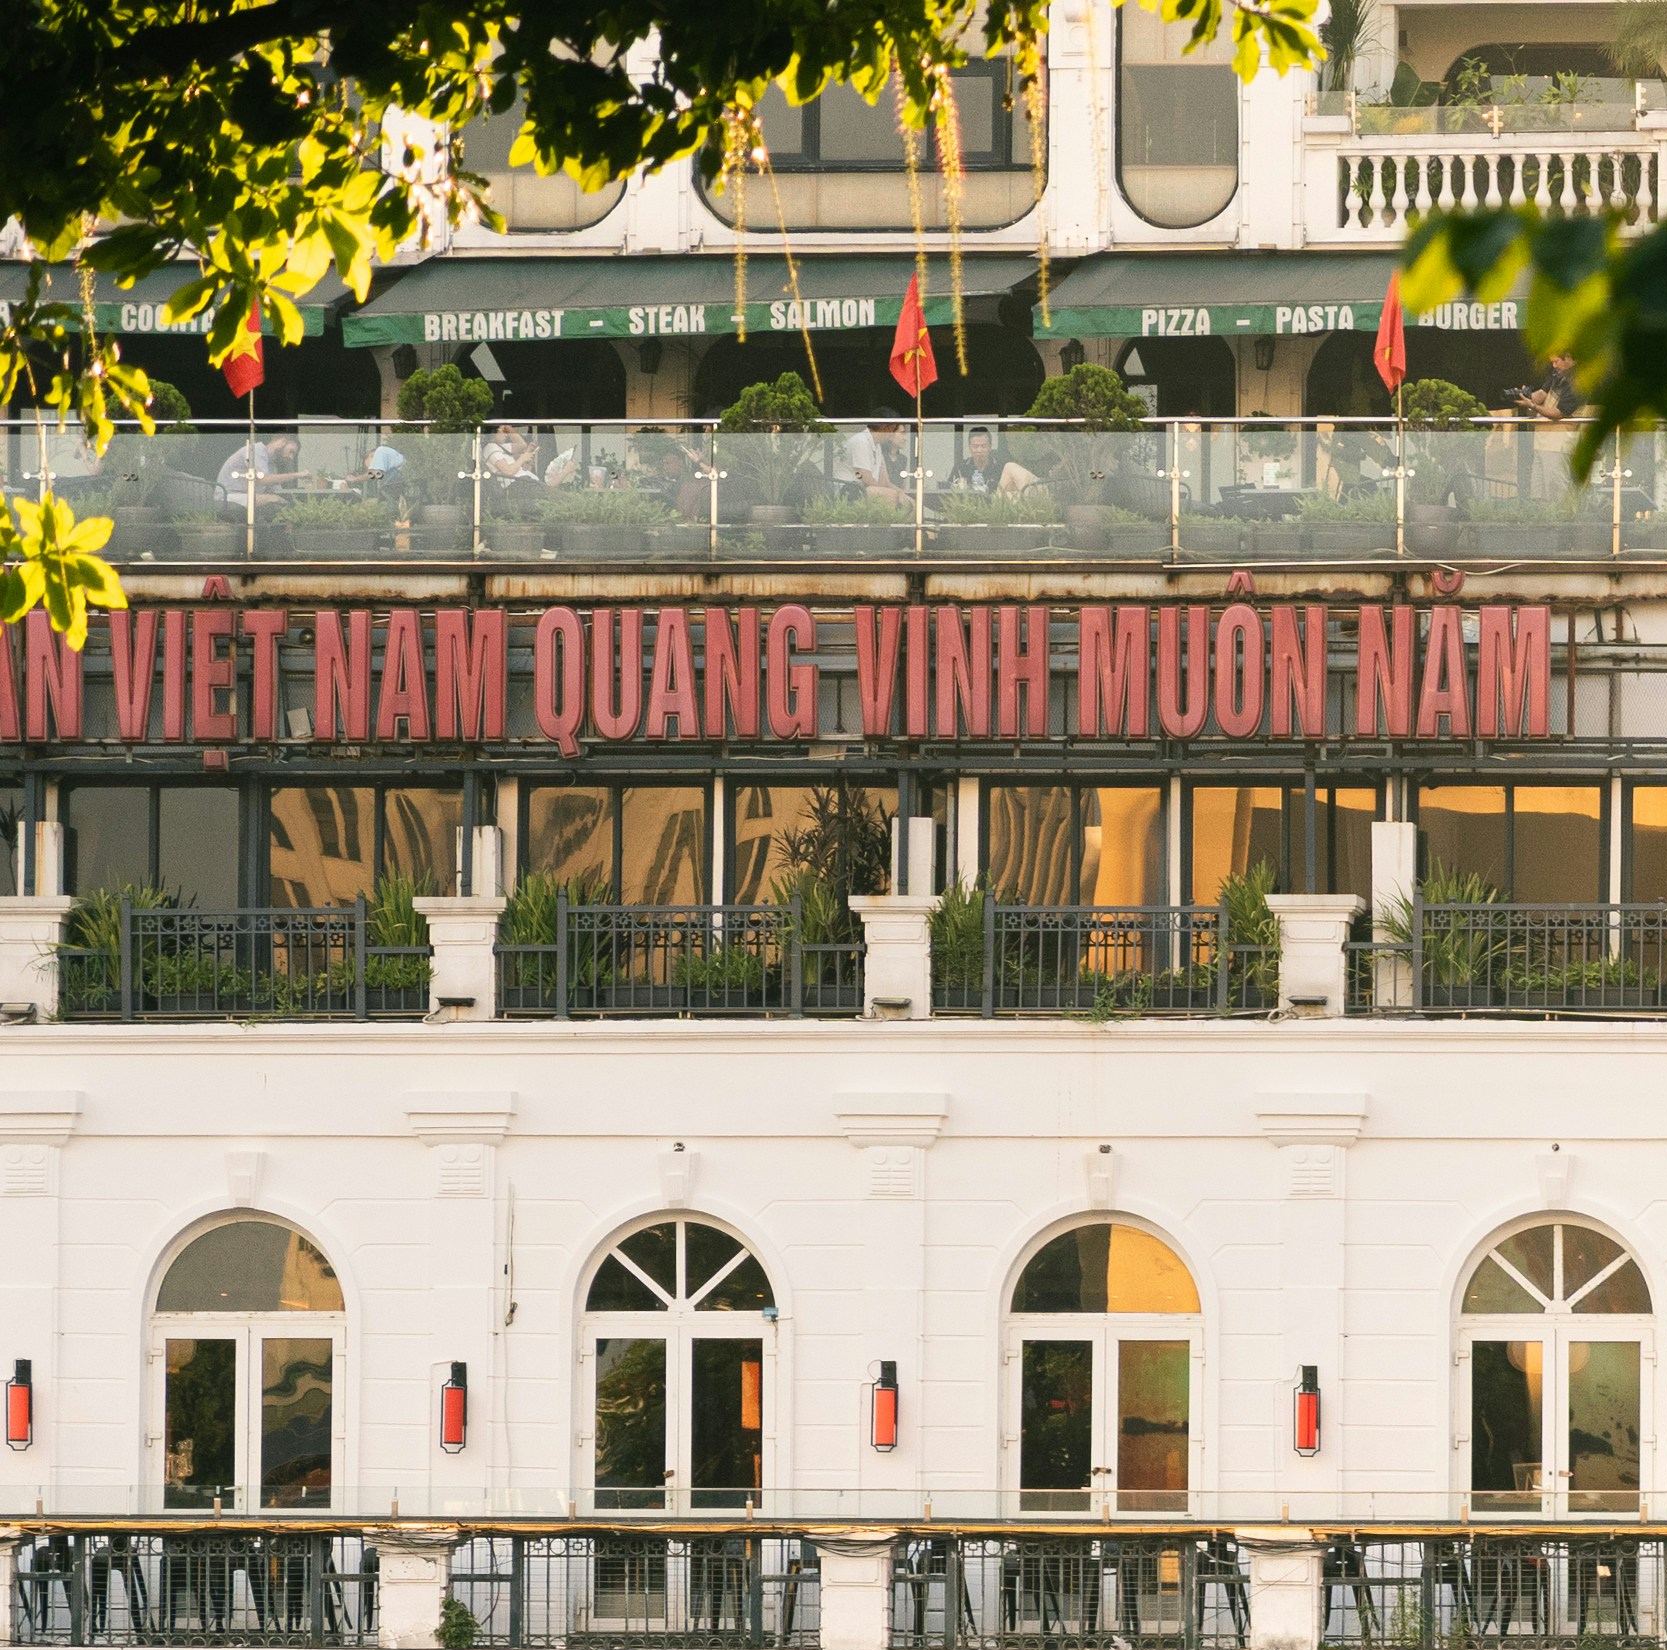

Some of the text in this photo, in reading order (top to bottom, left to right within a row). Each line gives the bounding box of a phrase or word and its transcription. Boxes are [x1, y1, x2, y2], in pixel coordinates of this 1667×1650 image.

[424, 305, 706, 343] BREAKFAST STEAK
[770, 298, 876, 332] SALMON
[1142, 304, 1355, 337] PIZZA PASTA
[1419, 300, 1518, 332] BURGER
[109, 569, 1551, 770] VIỆT NAM QUANG VINH MUÔN NĂM
